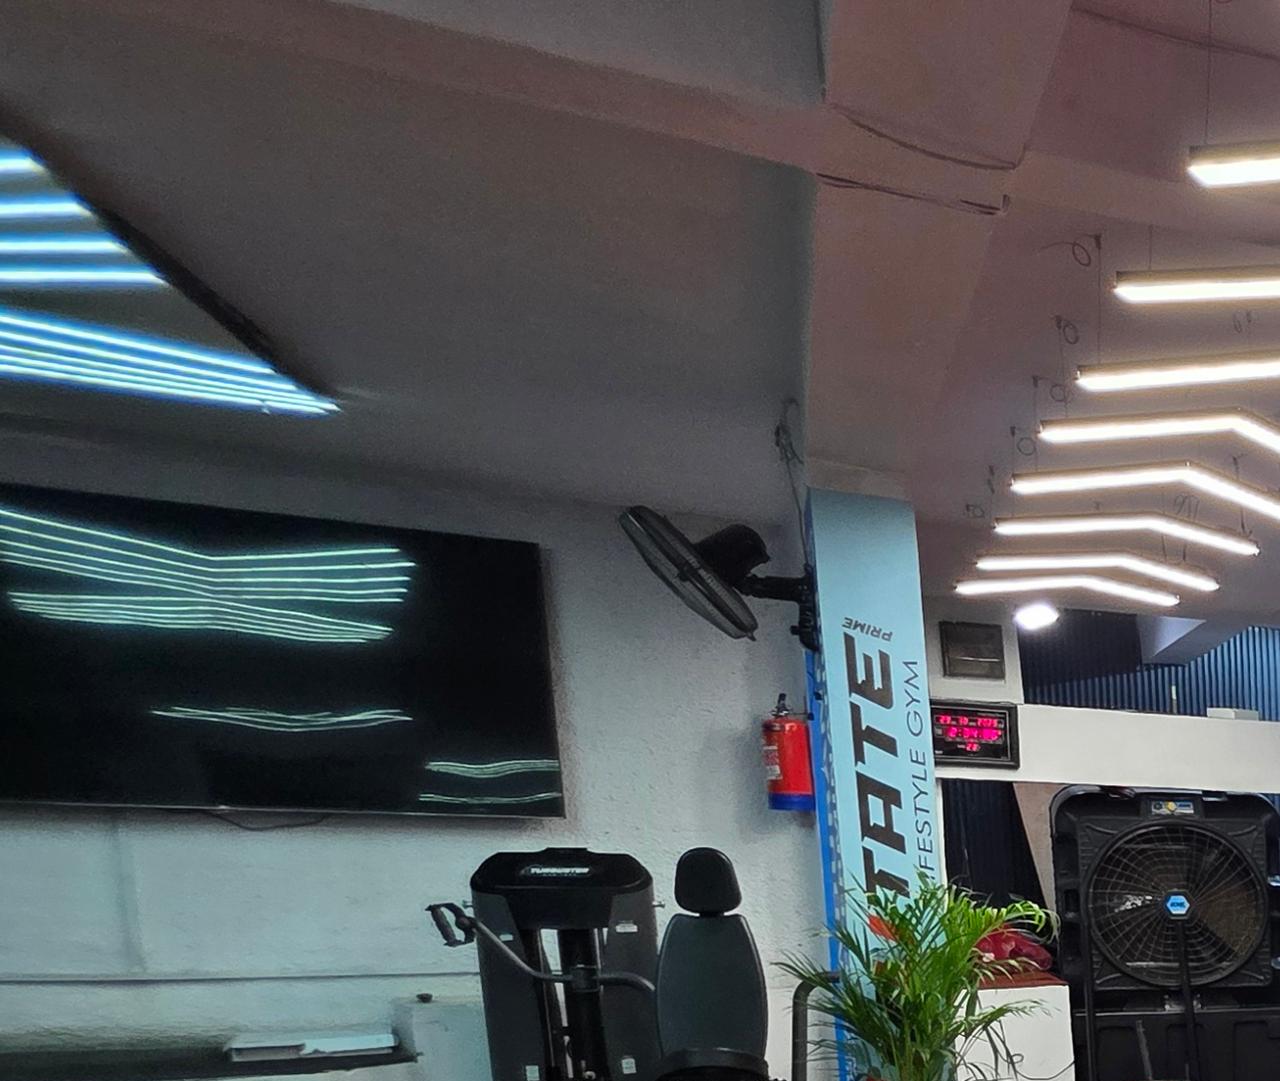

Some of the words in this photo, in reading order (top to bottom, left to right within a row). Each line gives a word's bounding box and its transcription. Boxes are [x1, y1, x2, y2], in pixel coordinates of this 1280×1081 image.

[841, 616, 893, 642] PRIME
[902, 660, 924, 737] GYM
[843, 631, 912, 942] TATE
[909, 748, 936, 880] FESTYLE
